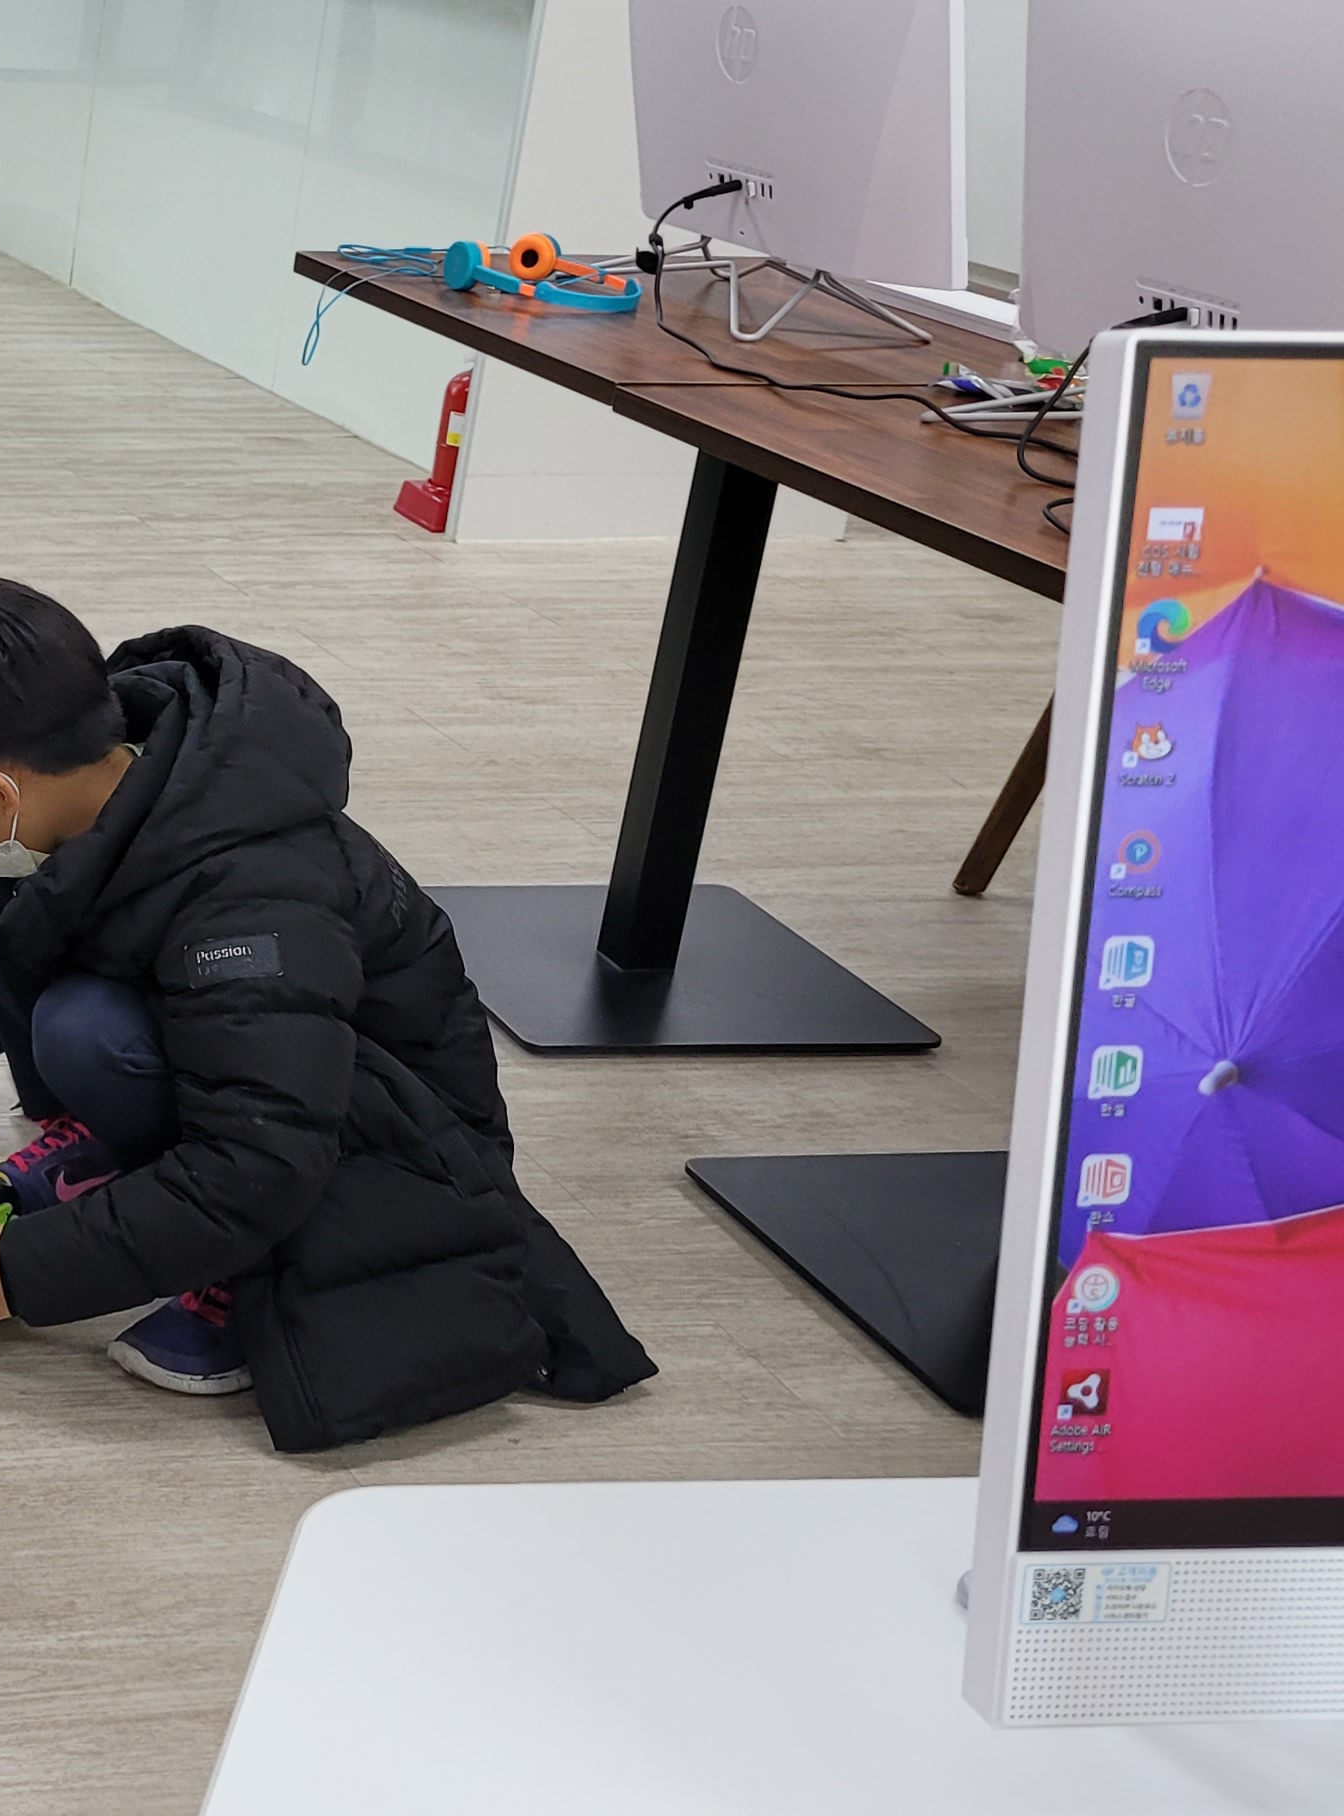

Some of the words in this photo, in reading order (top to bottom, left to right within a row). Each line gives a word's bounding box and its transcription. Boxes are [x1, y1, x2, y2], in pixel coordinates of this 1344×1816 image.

[1131, 658, 1188, 674] Microsoft
[1142, 676, 1172, 693] Edge
[1108, 884, 1162, 900] Compass
[1050, 1423, 1088, 1436] Adobe
[1091, 1423, 1112, 1436] AIR
[1050, 1440, 1095, 1455] Settings
